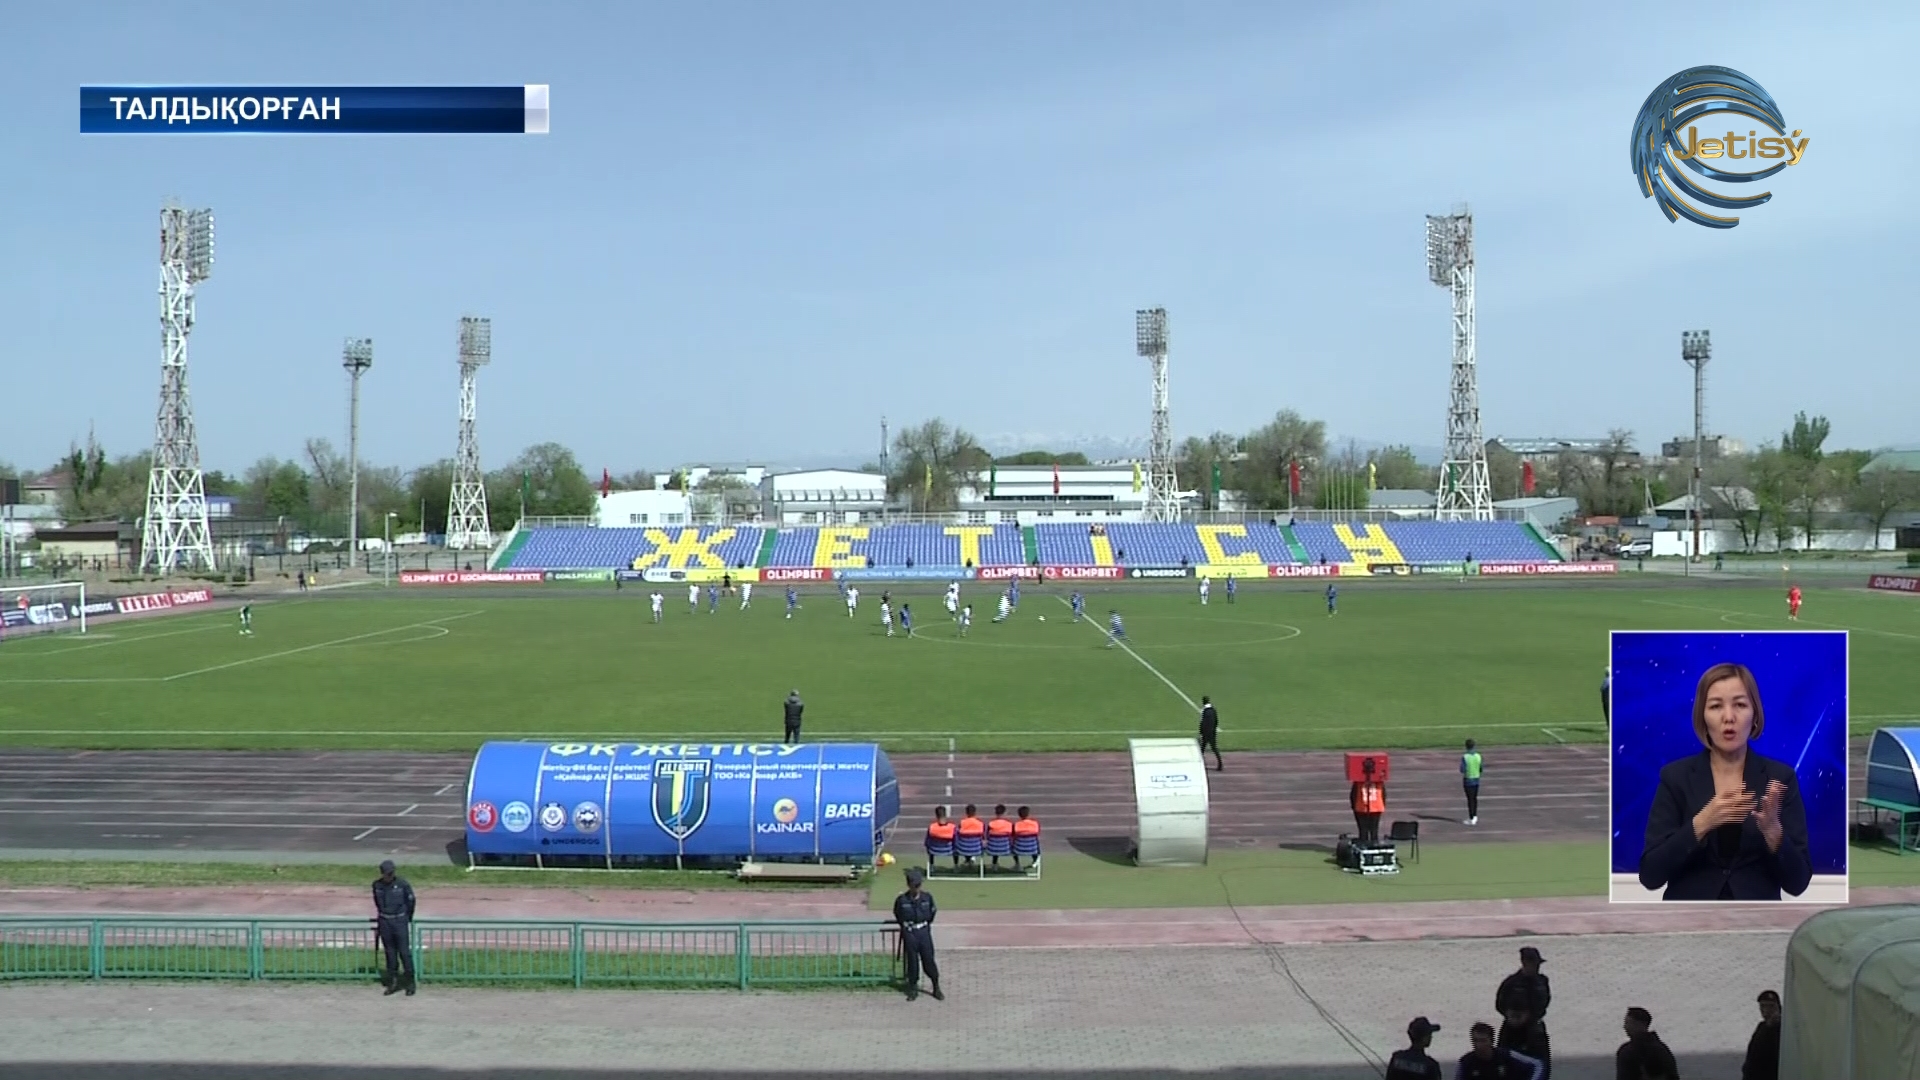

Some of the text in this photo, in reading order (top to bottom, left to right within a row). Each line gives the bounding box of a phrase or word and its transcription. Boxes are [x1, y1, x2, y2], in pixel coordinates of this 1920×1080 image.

[767, 569, 823, 580] OLIMPBET
[981, 567, 1038, 578] OLIMPBET
[1061, 567, 1117, 578] OLIMPBET
[1142, 569, 1187, 578] UNDERDOG
[1275, 566, 1331, 577] OLIMPBET
[1481, 565, 1524, 573] OLIMPBET
[402, 573, 445, 582] OLIMPBET
[172, 590, 208, 604] OLIMPBET
[121, 595, 170, 611] TITAN
[825, 804, 873, 819] BARS
[757, 823, 814, 833] KAINAR
